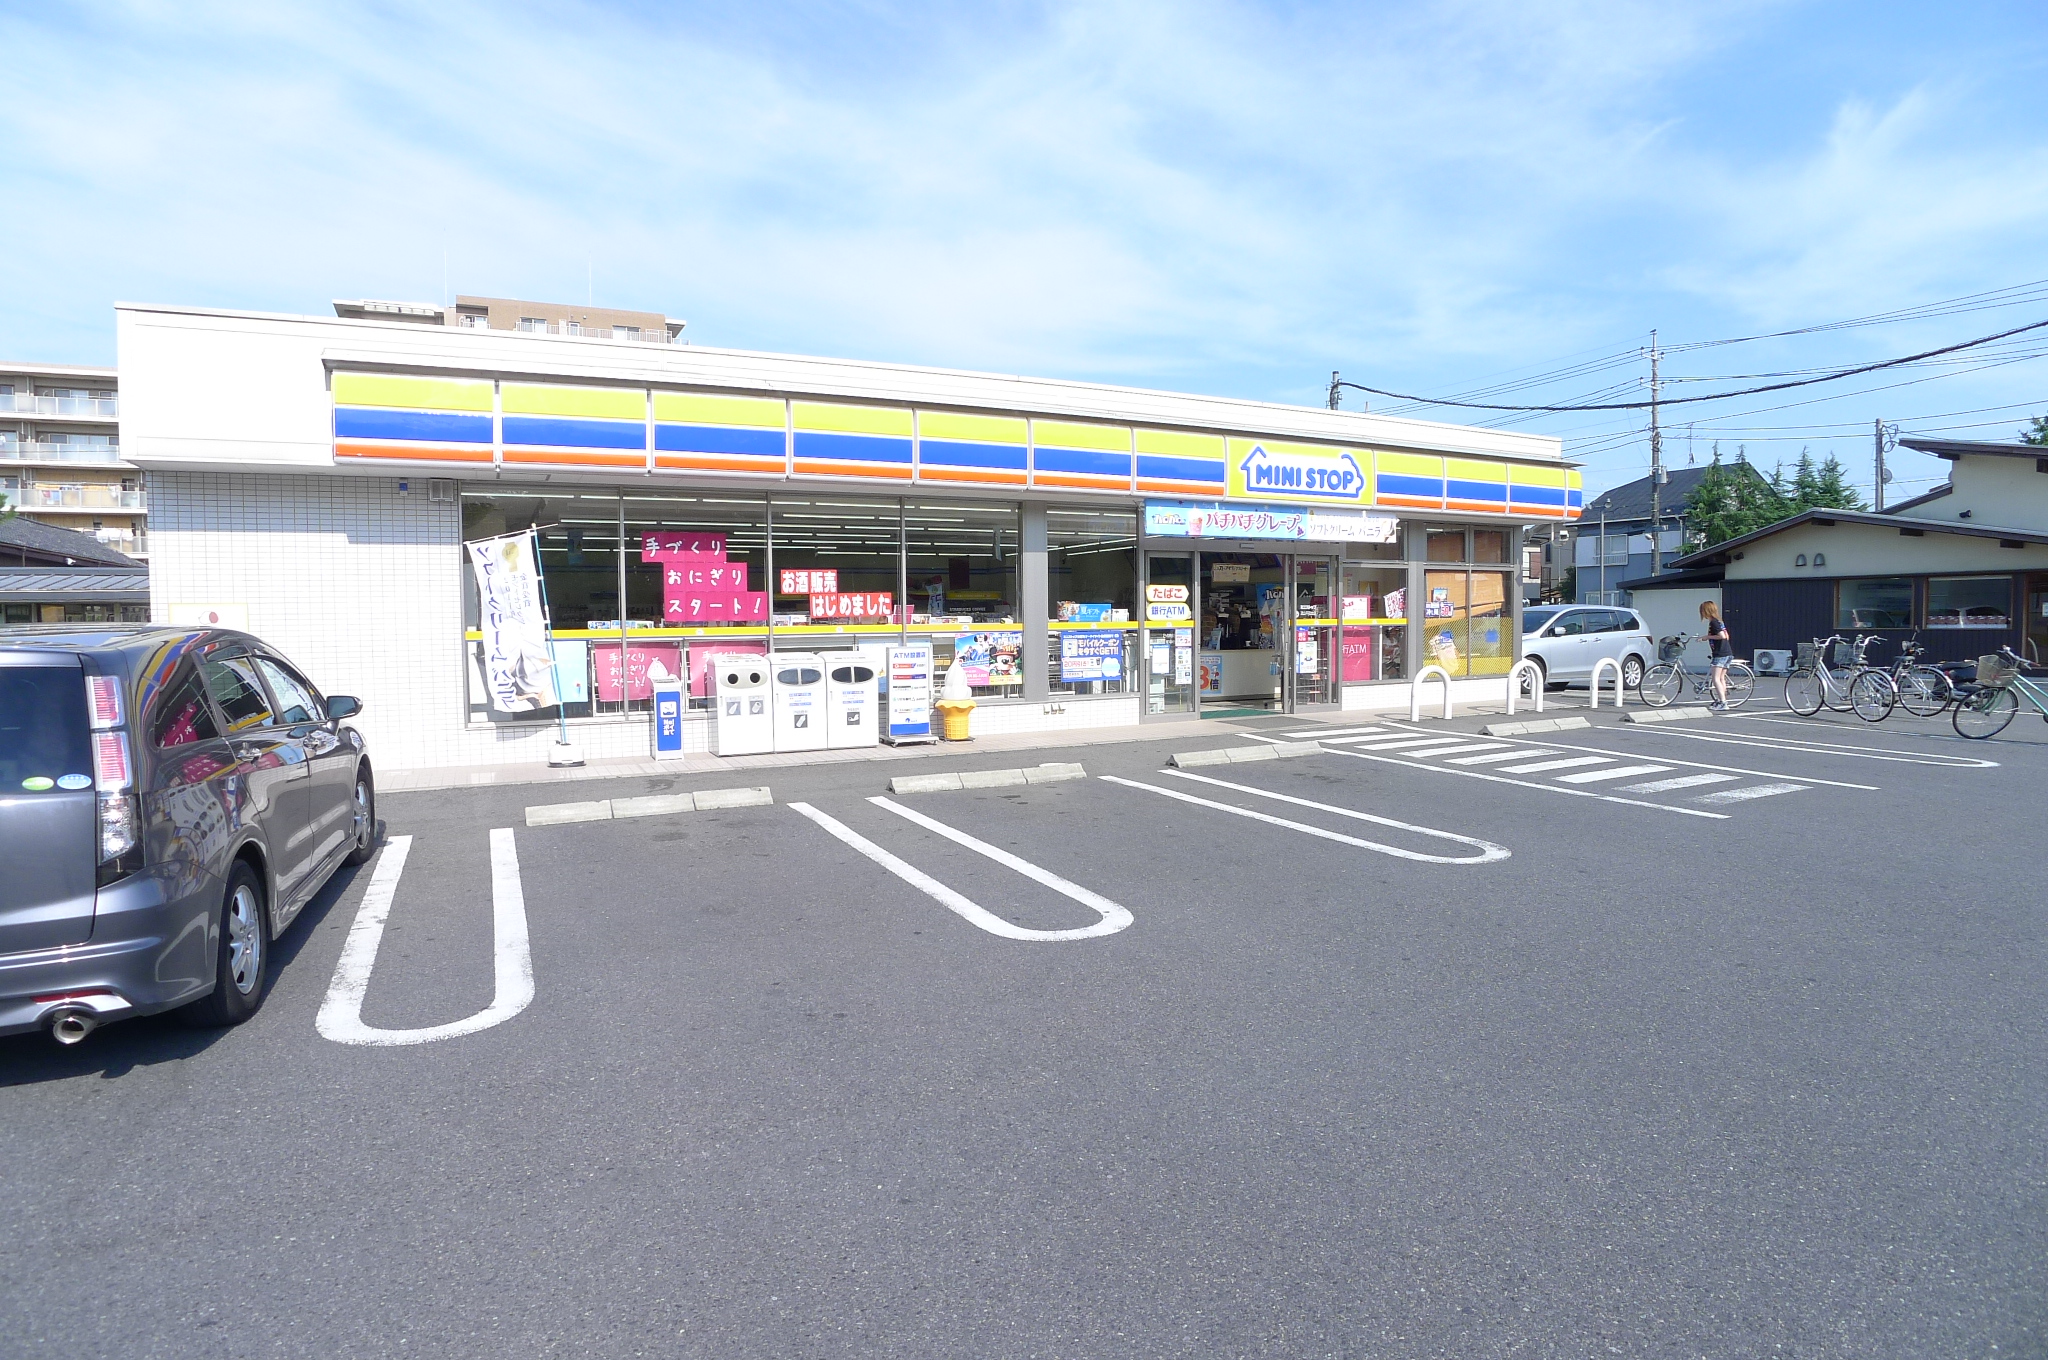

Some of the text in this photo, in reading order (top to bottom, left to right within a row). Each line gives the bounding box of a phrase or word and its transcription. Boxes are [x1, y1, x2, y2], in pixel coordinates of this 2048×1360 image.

[1256, 464, 1355, 490] MINI STOP
[1206, 512, 1301, 531] パチパチグレープ
[1310, 524, 1381, 537] ソフトクリーム バニラ
[645, 537, 721, 557] 手づくり
[667, 568, 742, 586] おにぎり
[782, 570, 837, 593] お酒販売
[1153, 587, 1183, 599] たばこ
[668, 597, 761, 616] スタート!
[811, 593, 891, 617] はじめました
[1080, 606, 1100, 615] 夏ギフト
[1151, 606, 1185, 615] 銀行ATM
[1078, 638, 1120, 647] モバイルクーポン
